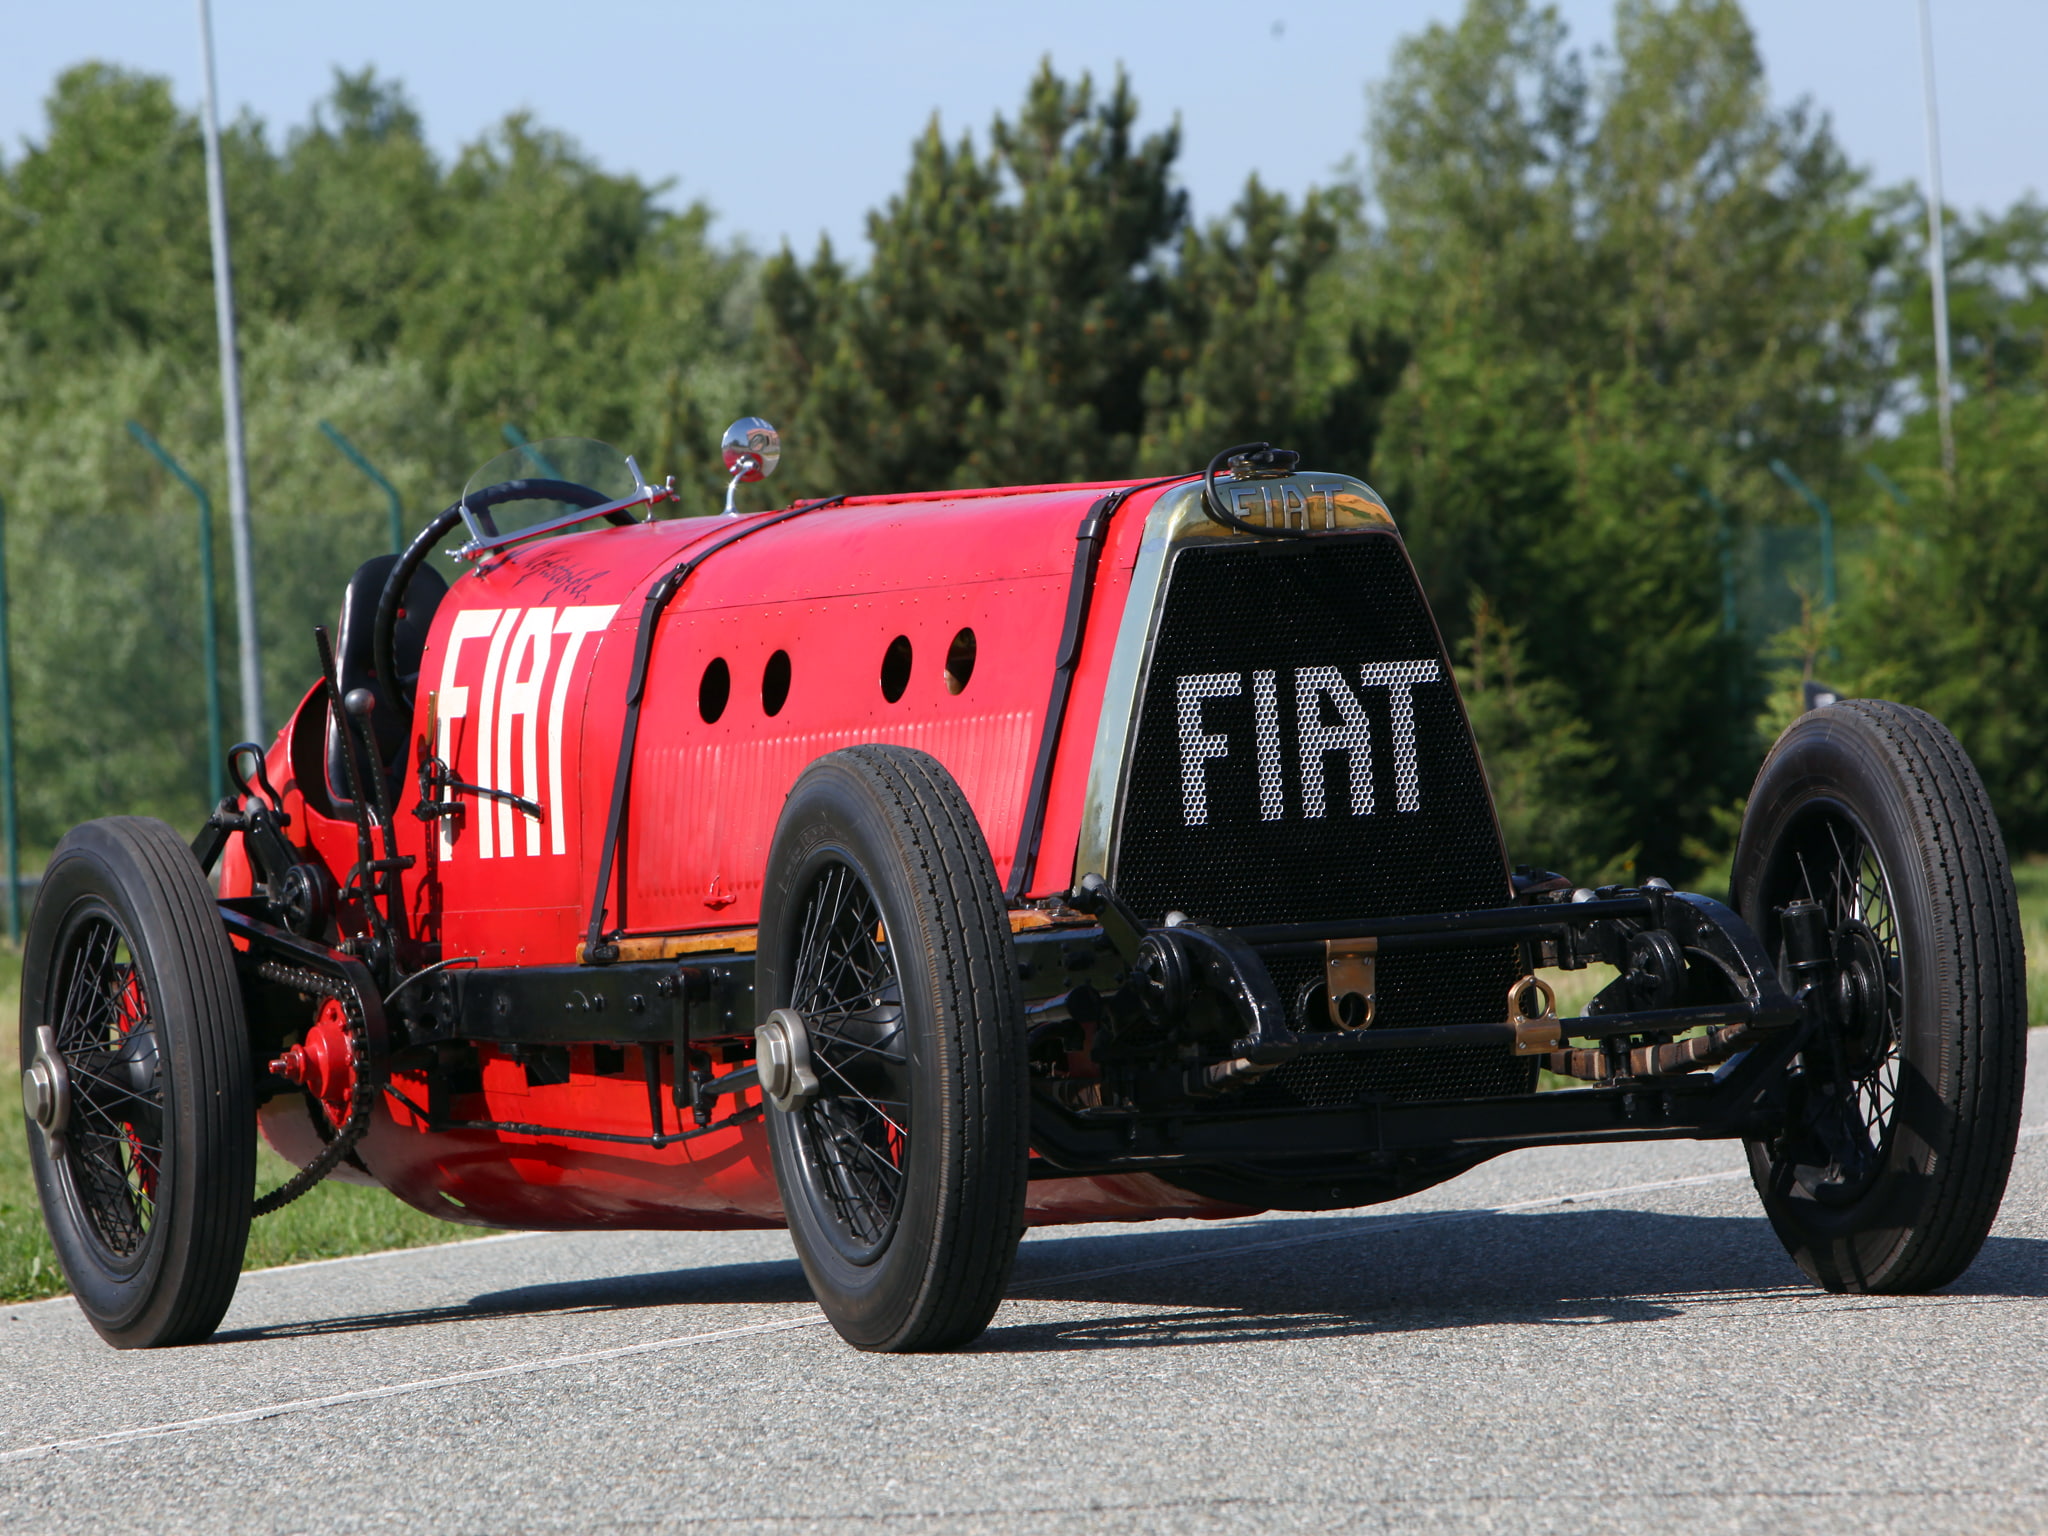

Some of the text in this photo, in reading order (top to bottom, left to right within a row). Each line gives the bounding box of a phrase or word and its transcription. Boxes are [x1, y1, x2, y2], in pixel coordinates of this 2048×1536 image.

[1229, 484, 1344, 535] FIAT
[438, 603, 621, 862] FIAT
[1176, 659, 1441, 827] FIAT
